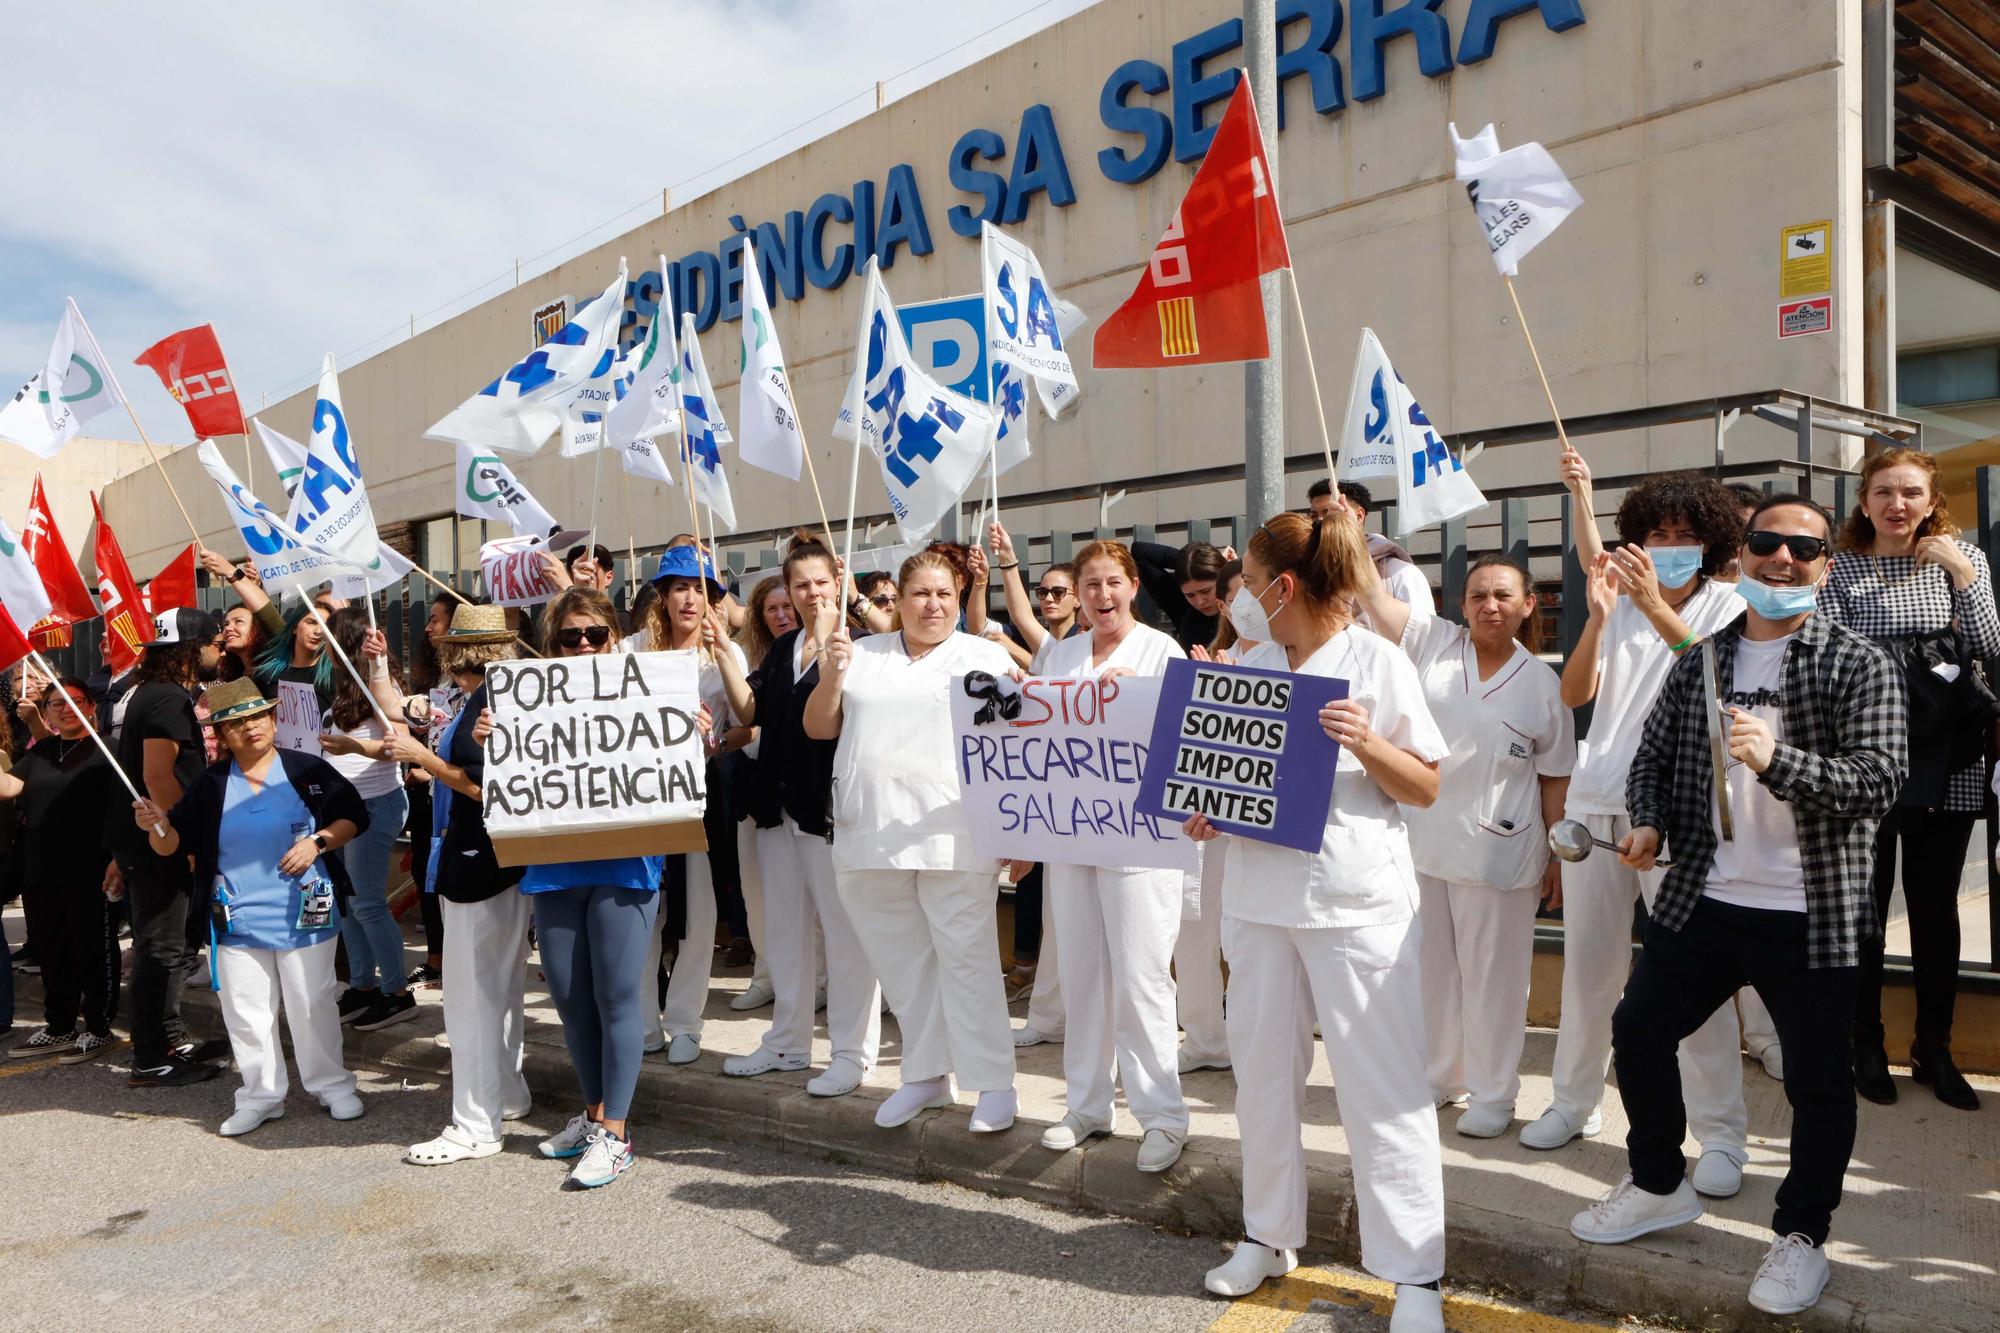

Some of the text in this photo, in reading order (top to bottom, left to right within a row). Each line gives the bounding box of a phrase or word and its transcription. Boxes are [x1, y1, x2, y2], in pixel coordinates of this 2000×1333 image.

[947, 103, 1077, 238] SA
[1785, 310, 1825, 322] ATENCIÓN
[912, 318, 980, 386] P
[485, 653, 651, 713] POR LA
[1009, 679, 1120, 727] STOP
[1197, 673, 1290, 709] TODOS
[1183, 710, 1284, 750] SOMOS
[1177, 748, 1274, 789] IMPOR
[1166, 782, 1274, 826] TANTES
